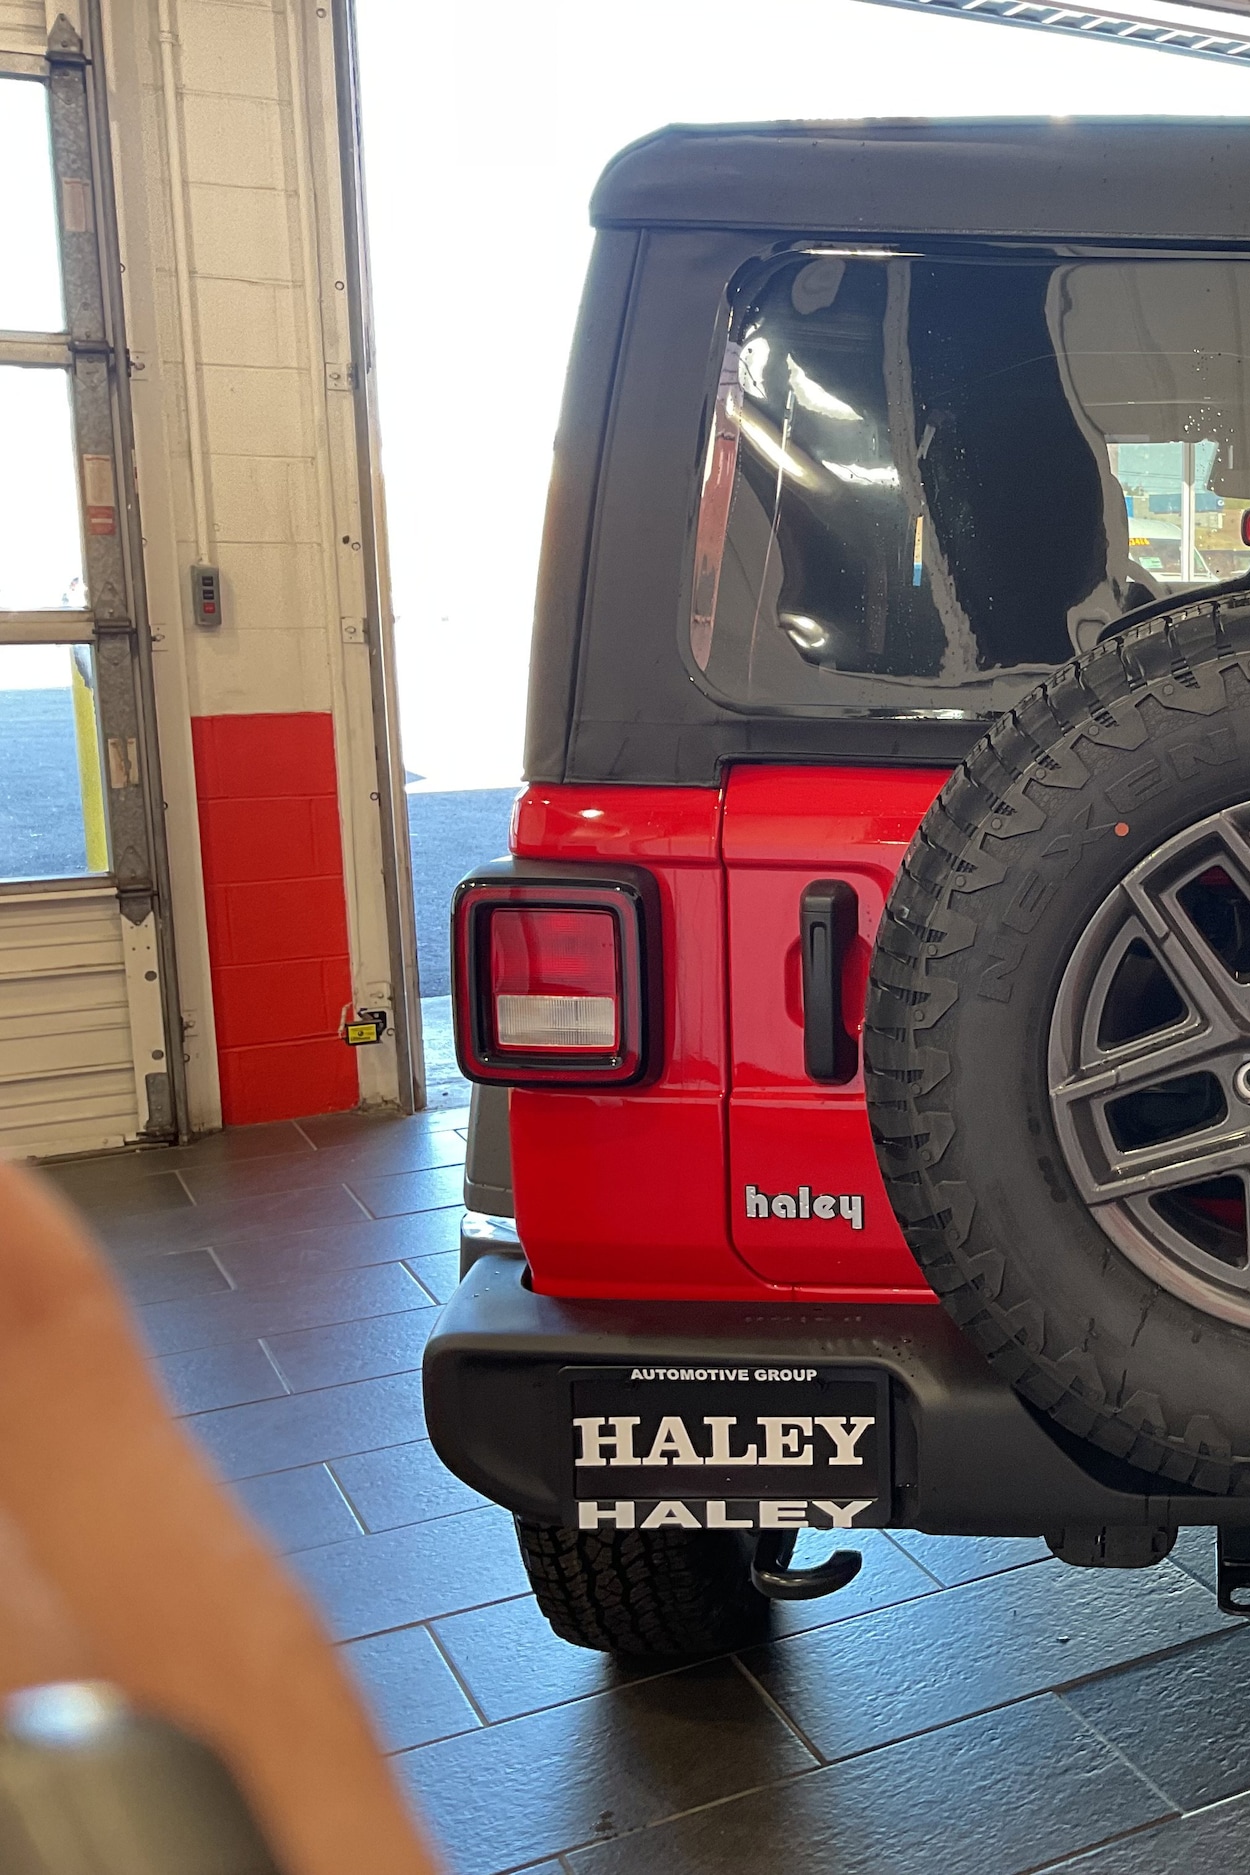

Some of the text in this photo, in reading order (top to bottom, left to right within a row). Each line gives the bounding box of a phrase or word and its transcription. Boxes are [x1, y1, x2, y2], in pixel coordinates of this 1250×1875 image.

[977, 727, 1241, 1004] NEXEN
[745, 1185, 862, 1229] haley
[631, 1368, 818, 1382] AUTOMOTIVE GROUP
[573, 1416, 875, 1466] HALEY
[578, 1501, 873, 1529] HALEY
